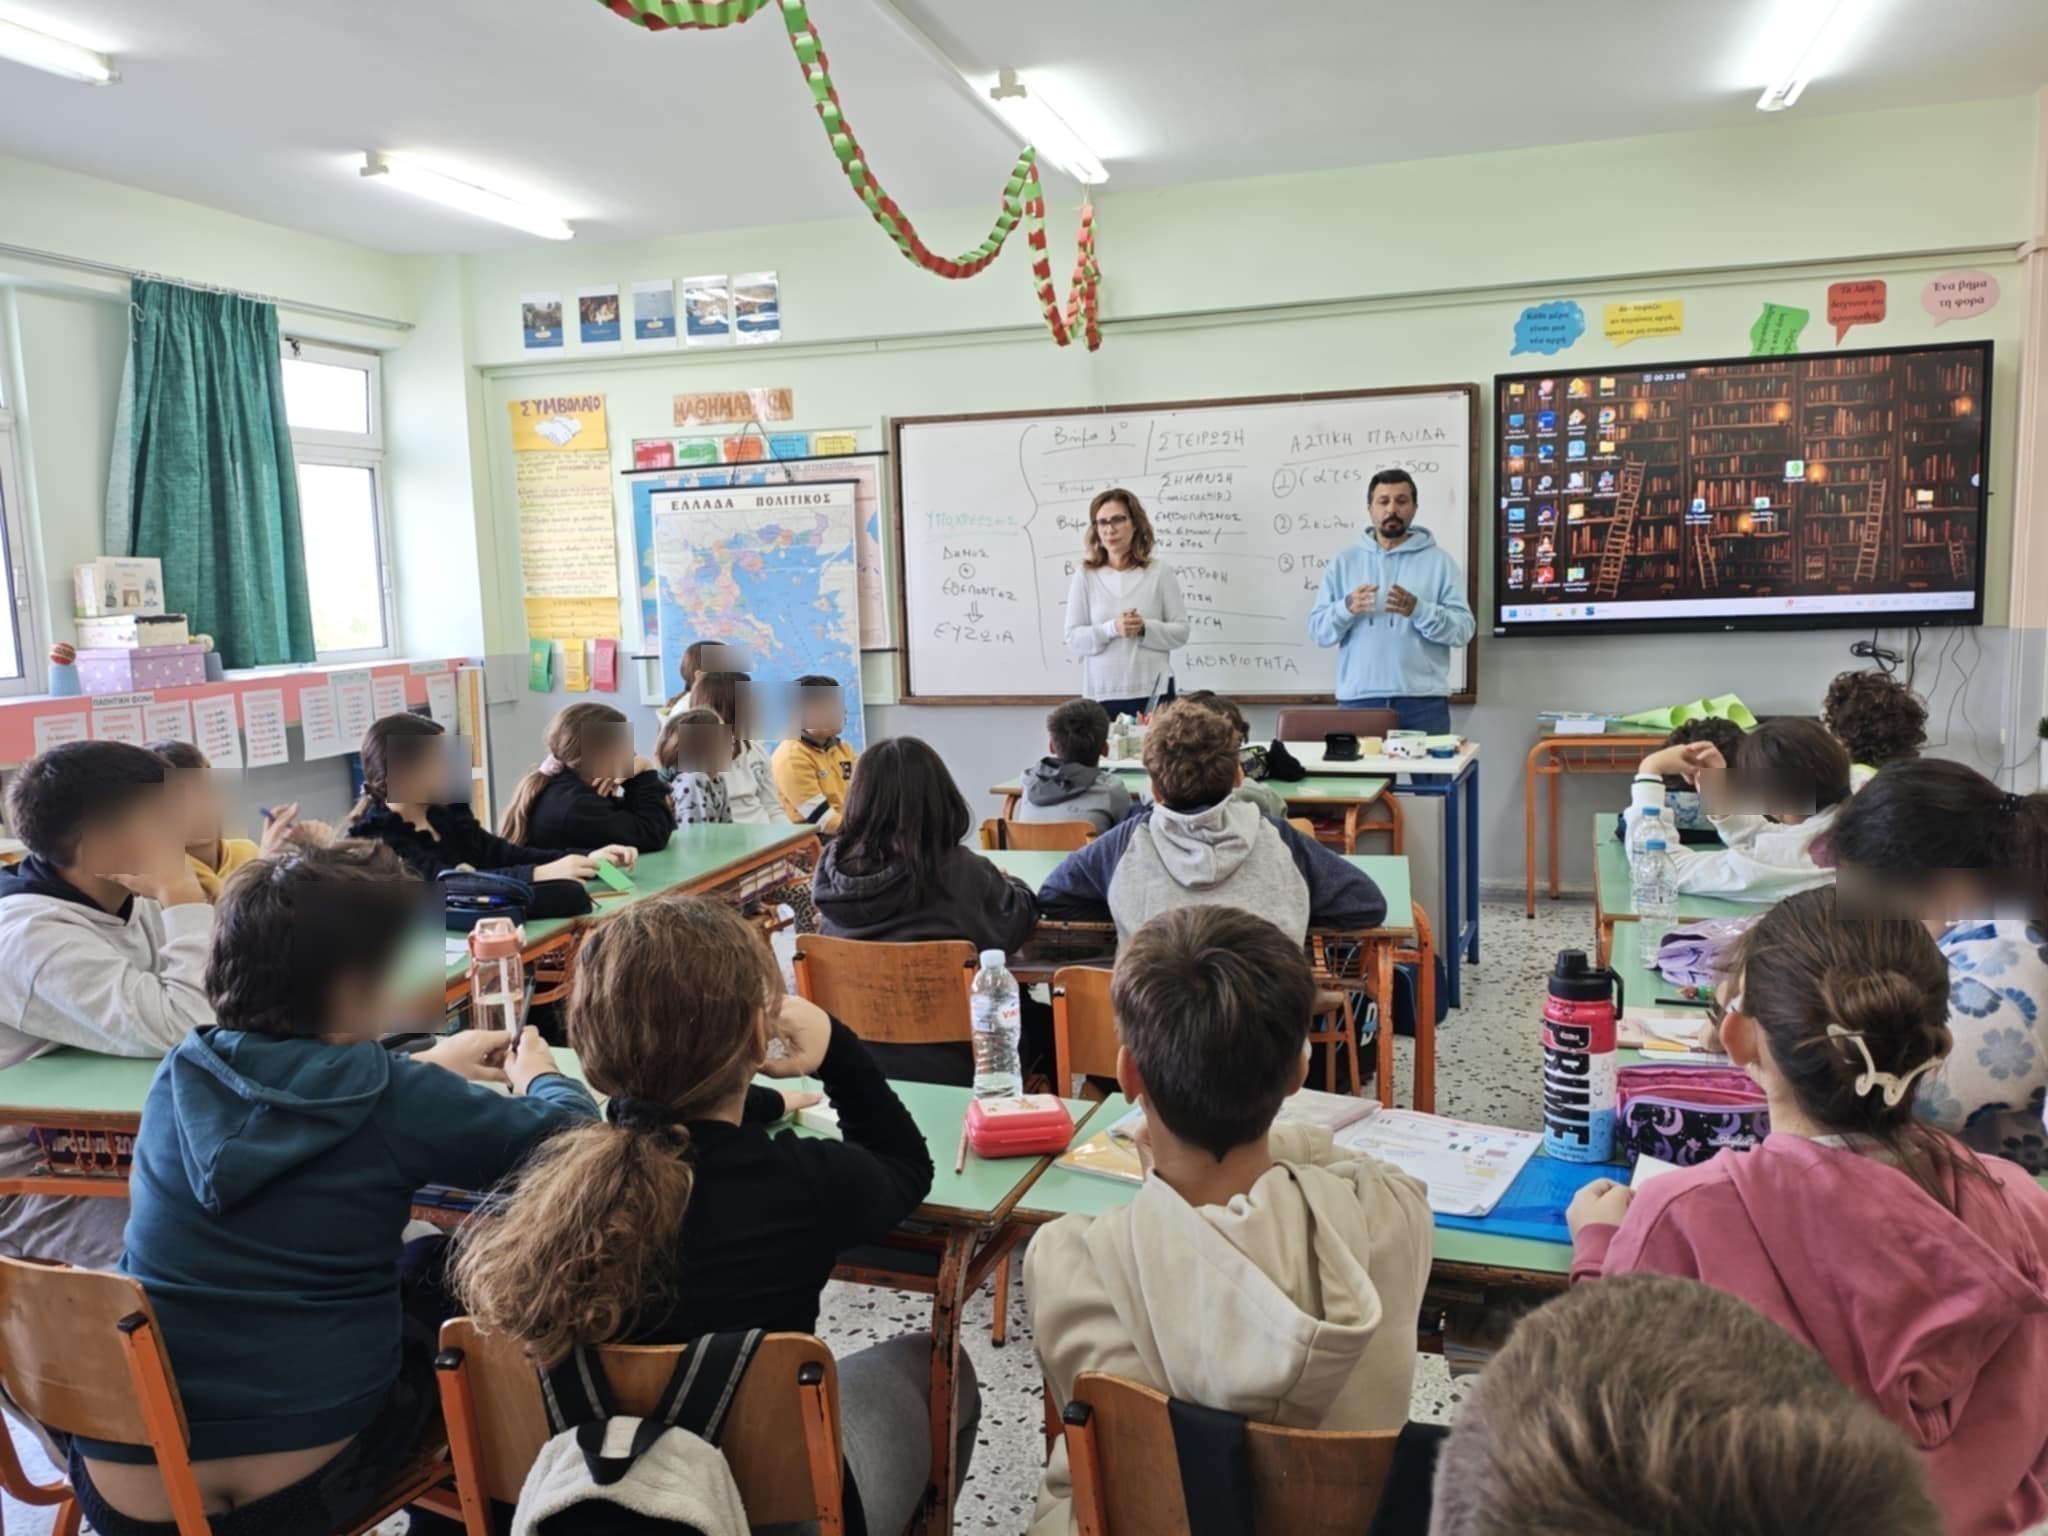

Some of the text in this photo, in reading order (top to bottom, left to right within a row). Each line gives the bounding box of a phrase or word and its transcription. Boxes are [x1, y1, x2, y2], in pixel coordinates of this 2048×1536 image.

[1958, 279, 1987, 293] βήμα
[1954, 296, 1985, 308] φορά
[1160, 428, 1245, 451] ΣΤΕΙΡΩΣΗ
[1291, 427, 1447, 454] ΑΣΤΙΚΗ ΠΑΝΙΔΑ
[671, 493, 832, 512] ΕΛΛΑΔΑ ΠΟΛΙΤΙΚΟΣ
[1186, 653, 1300, 676] ΚΑΘΑΡΙΟΤΗΤΑ
